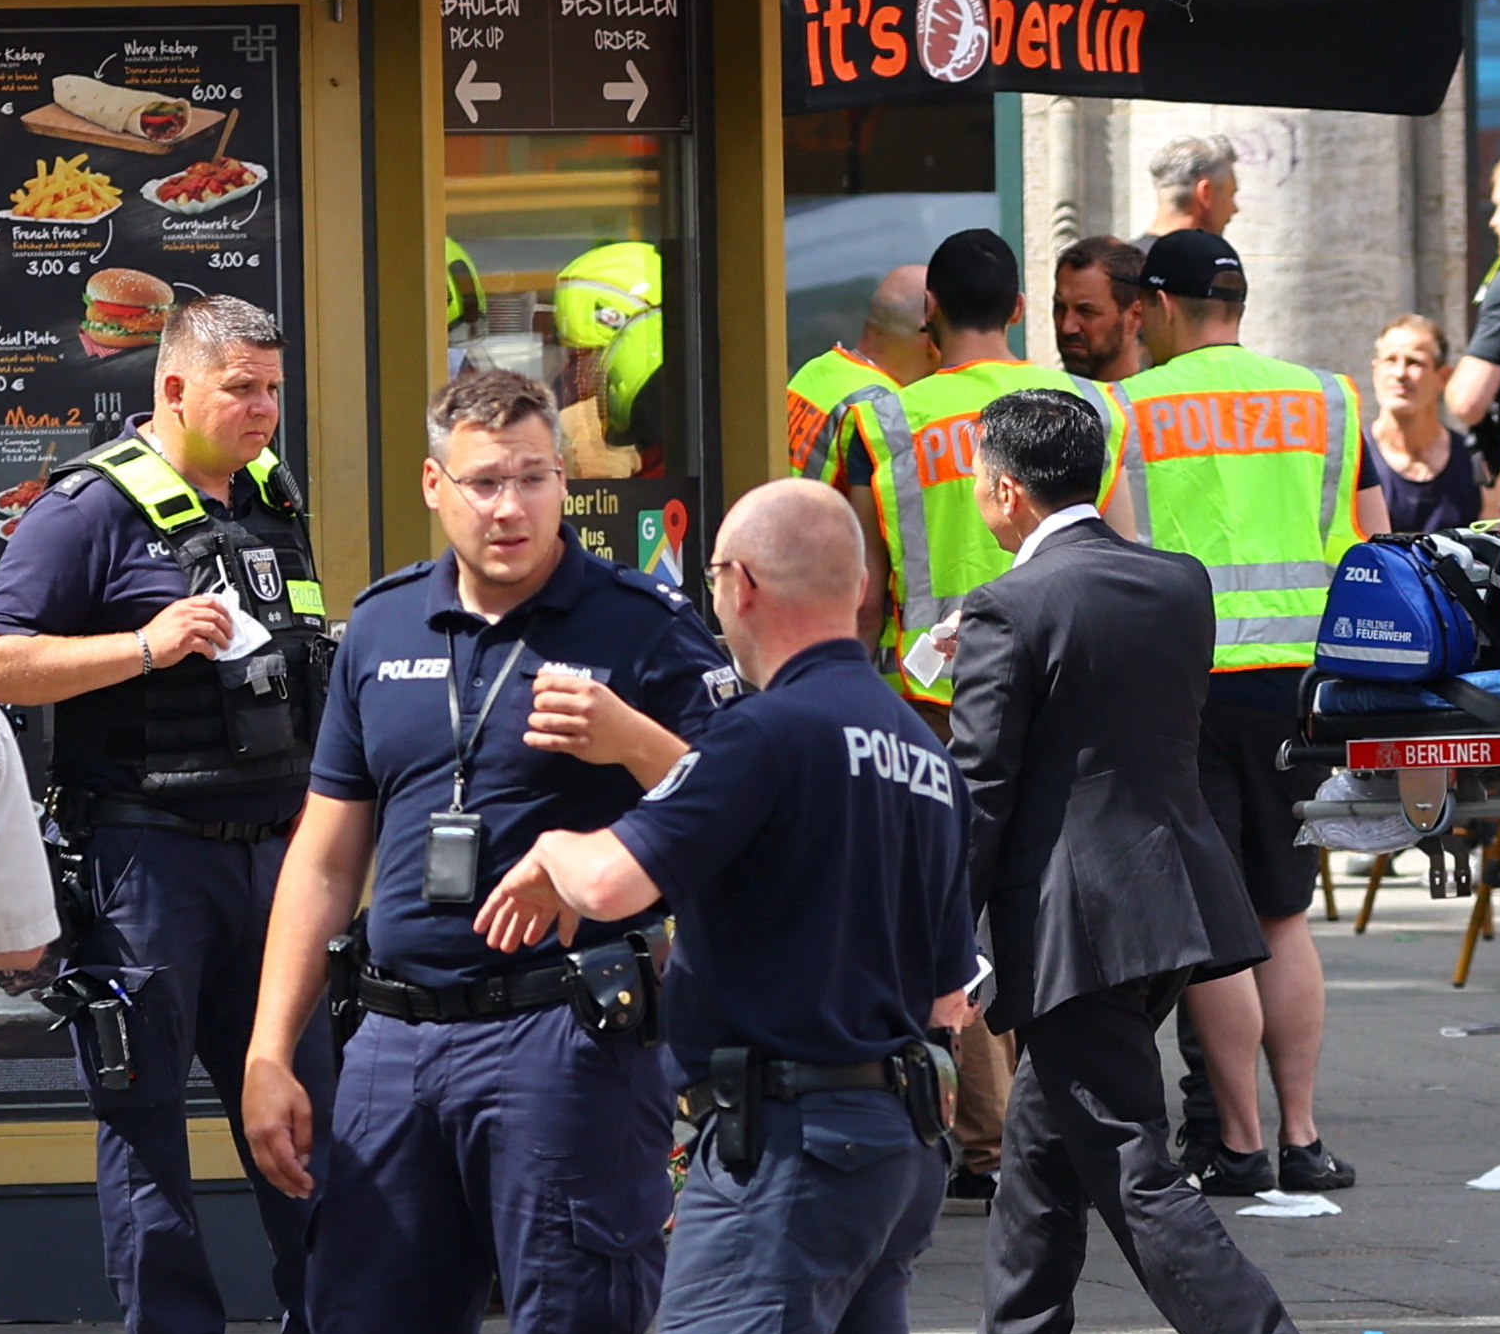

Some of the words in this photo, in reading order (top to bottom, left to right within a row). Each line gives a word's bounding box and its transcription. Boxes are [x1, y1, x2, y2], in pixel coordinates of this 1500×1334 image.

[594, 29, 650, 51] ORDER
[4, 47, 46, 66] Kebap
[124, 39, 157, 61] Wrap
[191, 84, 226, 103] 6,00
[229, 87, 243, 100] €
[0, 102, 14, 115] €
[12, 226, 50, 241] French
[25, 259, 64, 278] 3,00
[67, 261, 81, 275] €
[208, 251, 244, 270] 3,00
[246, 254, 260, 267] €
[23, 330, 60, 347] Plate
[11, 378, 25, 391] €
[4, 405, 62, 429] Menu
[65, 407, 82, 427] 2
[1150, 395, 1318, 455] POLIZEI
[642, 517, 656, 541] G
[1344, 566, 1383, 585] ZOLL
[1356, 618, 1395, 632] BERLINER
[1355, 628, 1413, 644] FEUERWEHR
[377, 658, 451, 683] POLIZEI
[1405, 742, 1492, 766] BERLINER
[843, 726, 955, 809] POLIZEI
